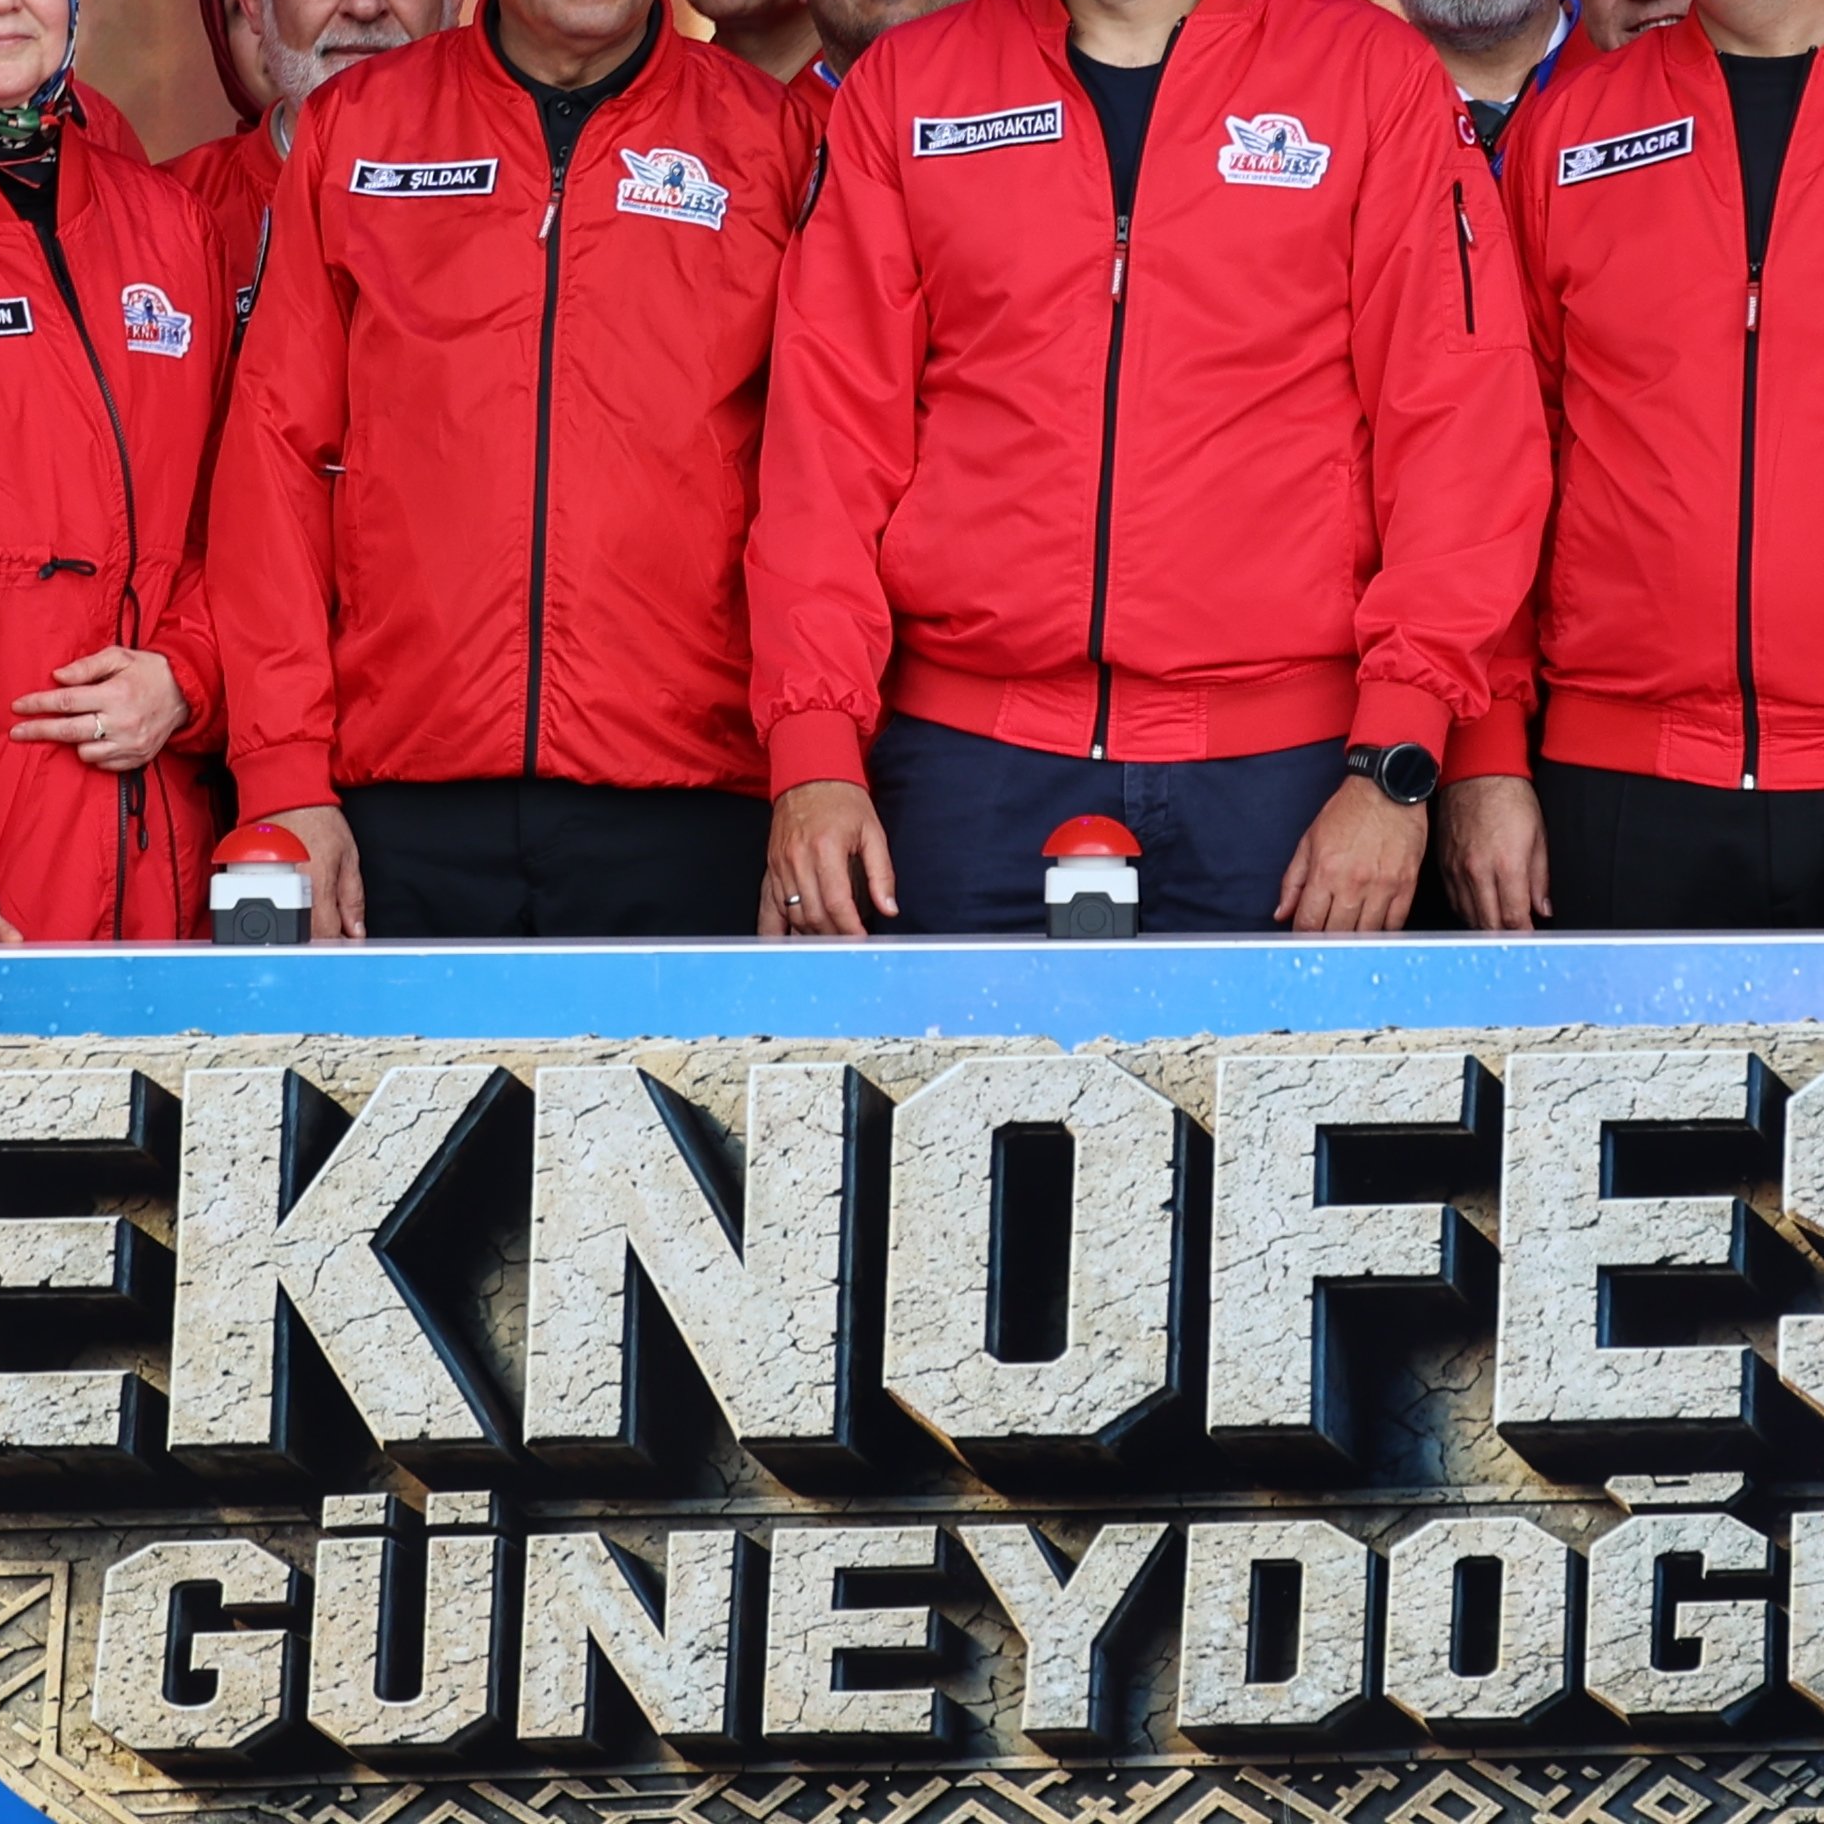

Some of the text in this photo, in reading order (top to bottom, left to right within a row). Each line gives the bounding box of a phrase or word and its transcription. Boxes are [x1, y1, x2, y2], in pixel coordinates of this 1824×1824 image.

[965, 110, 1057, 146] BAYRAKTAR
[1613, 130, 1680, 164] KACIR
[409, 167, 477, 190] ŞILDAK
[1228, 152, 1321, 177] TEKNOFEST
[622, 181, 725, 217] TEKNOFEST
